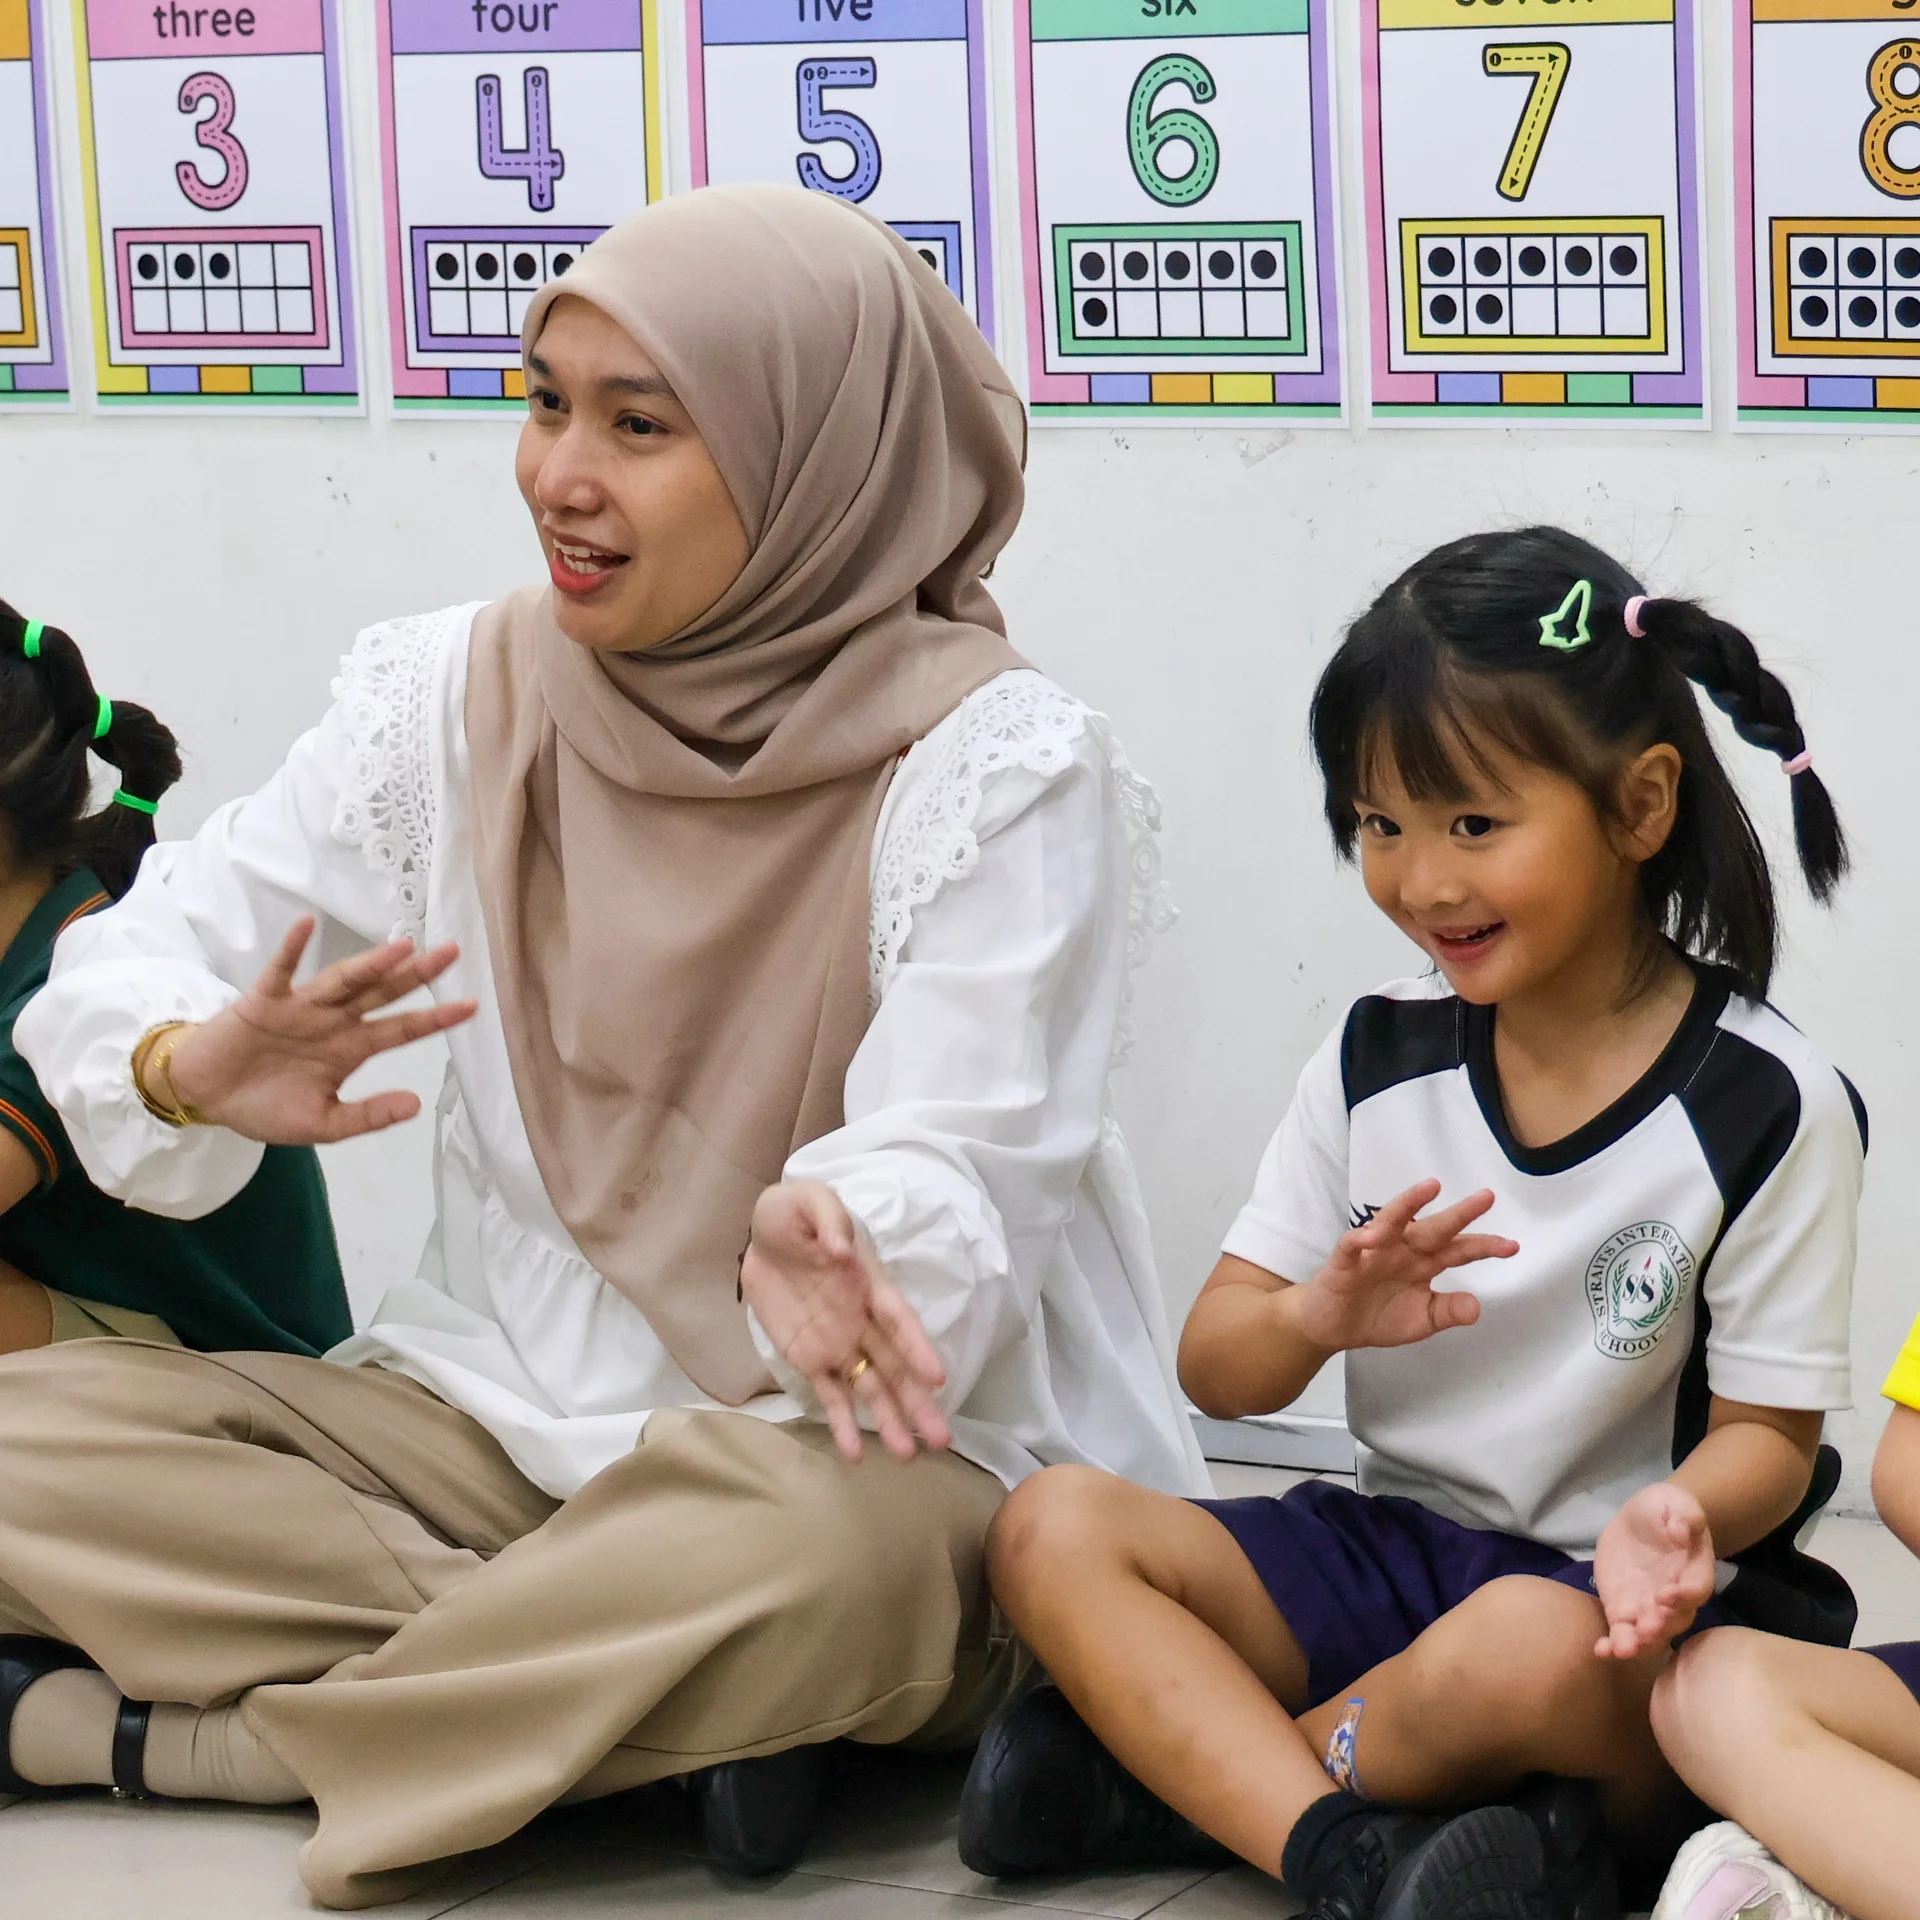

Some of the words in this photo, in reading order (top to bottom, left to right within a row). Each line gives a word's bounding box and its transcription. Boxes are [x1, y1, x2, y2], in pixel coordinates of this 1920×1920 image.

[153, 1, 256, 38] three
[472, 0, 559, 33] four
[175, 71, 249, 211] 3
[475, 66, 565, 213] 4
[796, 56, 882, 205] 5
[1126, 53, 1220, 208] 6
[1481, 41, 1572, 202] 7
[1858, 37, 1920, 201] 8
[1590, 1244, 1616, 1317] STRAITS
[1615, 1225, 1692, 1314] INTERNATIO
